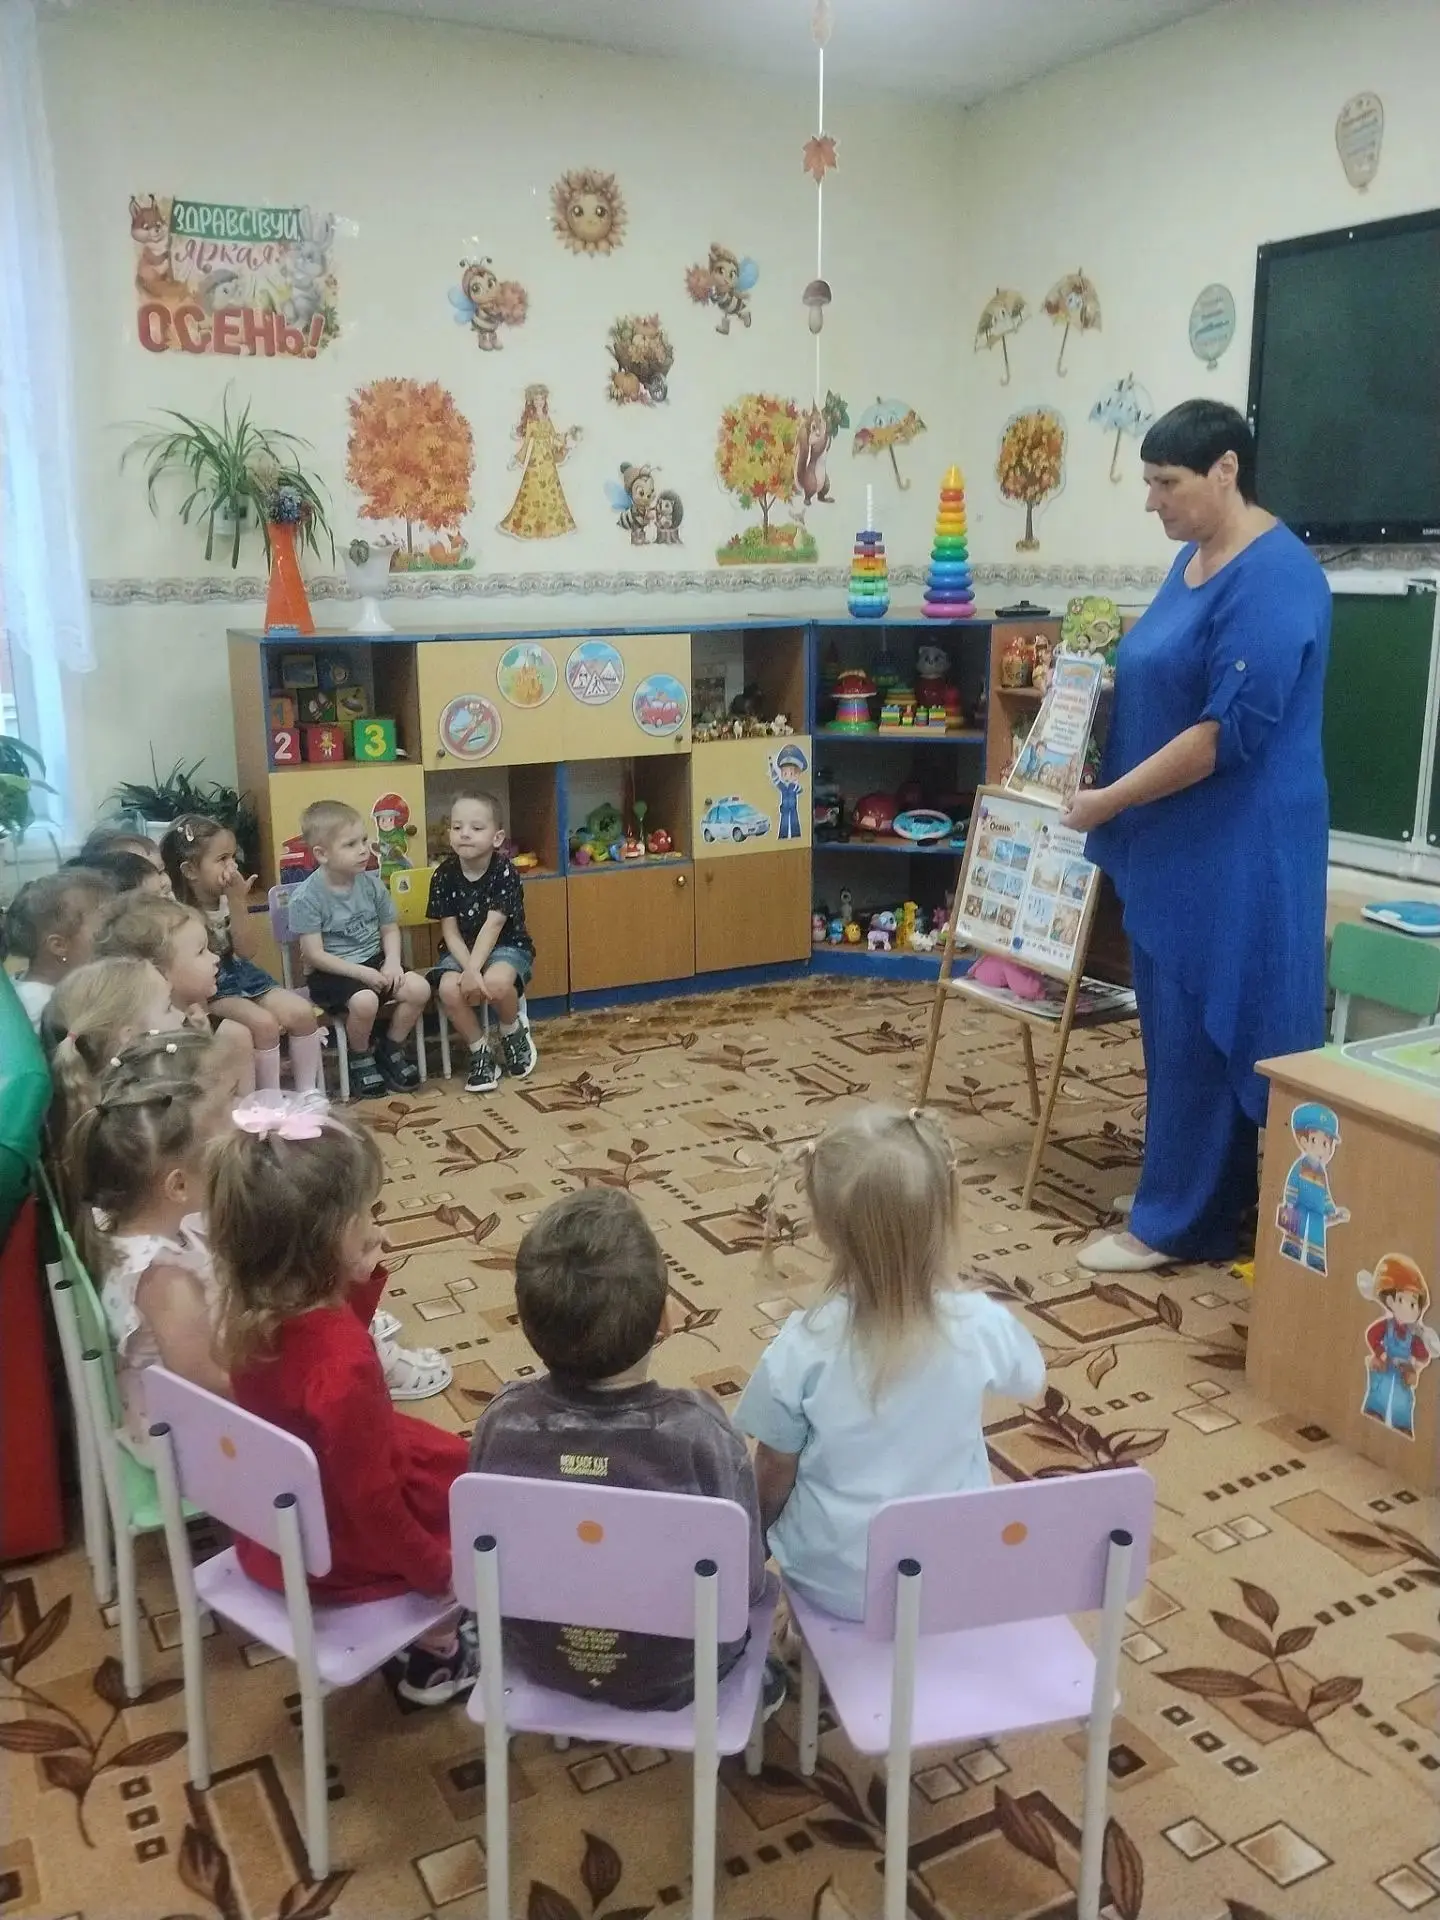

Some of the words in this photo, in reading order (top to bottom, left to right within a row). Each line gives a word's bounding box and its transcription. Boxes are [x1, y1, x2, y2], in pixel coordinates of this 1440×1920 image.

[172, 203, 299, 240] ЗДРАВСТВУЙ
[138, 304, 324, 359] ОСЕНЬ!
[274, 732, 292, 760] 2
[364, 724, 386, 757] 3
